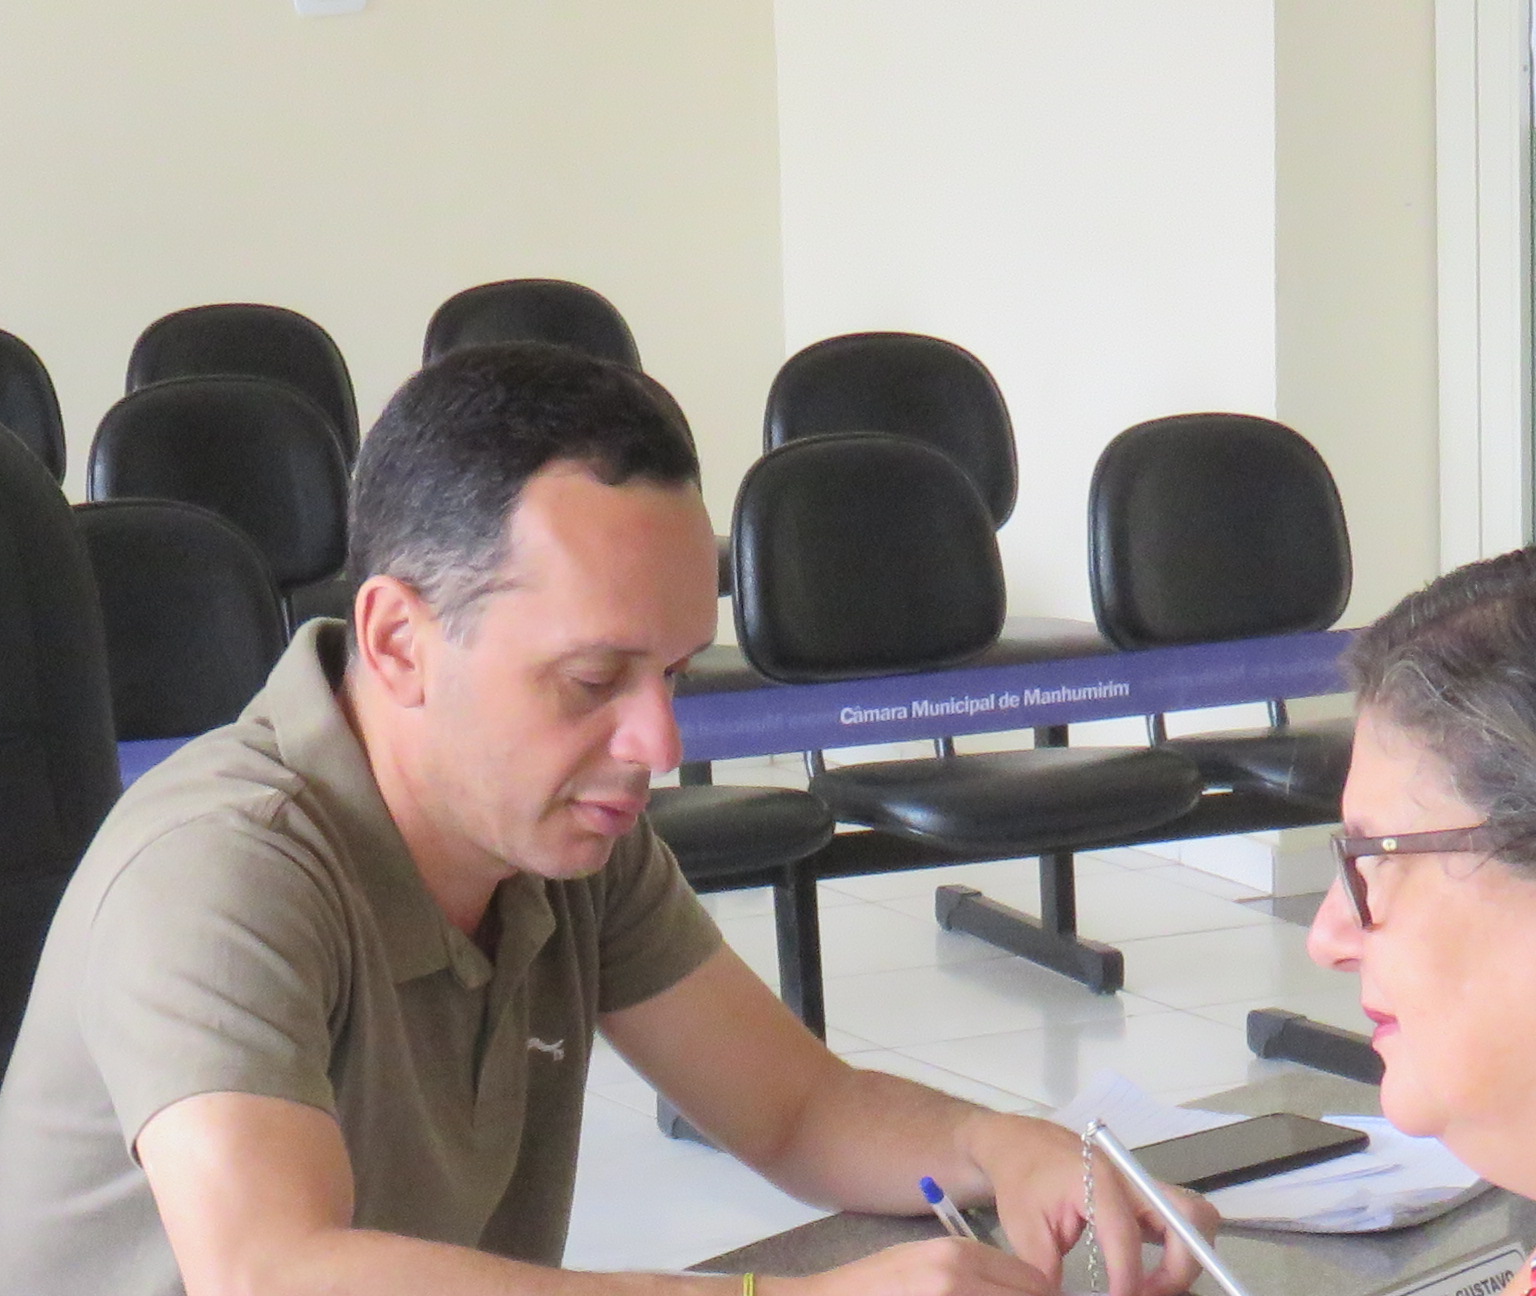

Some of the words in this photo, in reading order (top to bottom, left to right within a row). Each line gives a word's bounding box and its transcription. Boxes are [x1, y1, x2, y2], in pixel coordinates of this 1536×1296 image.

[840, 706, 908, 725] Câmara
[912, 692, 996, 717] Municipal
[998, 691, 1020, 709] de
[1024, 680, 1130, 706] Manhumirim
